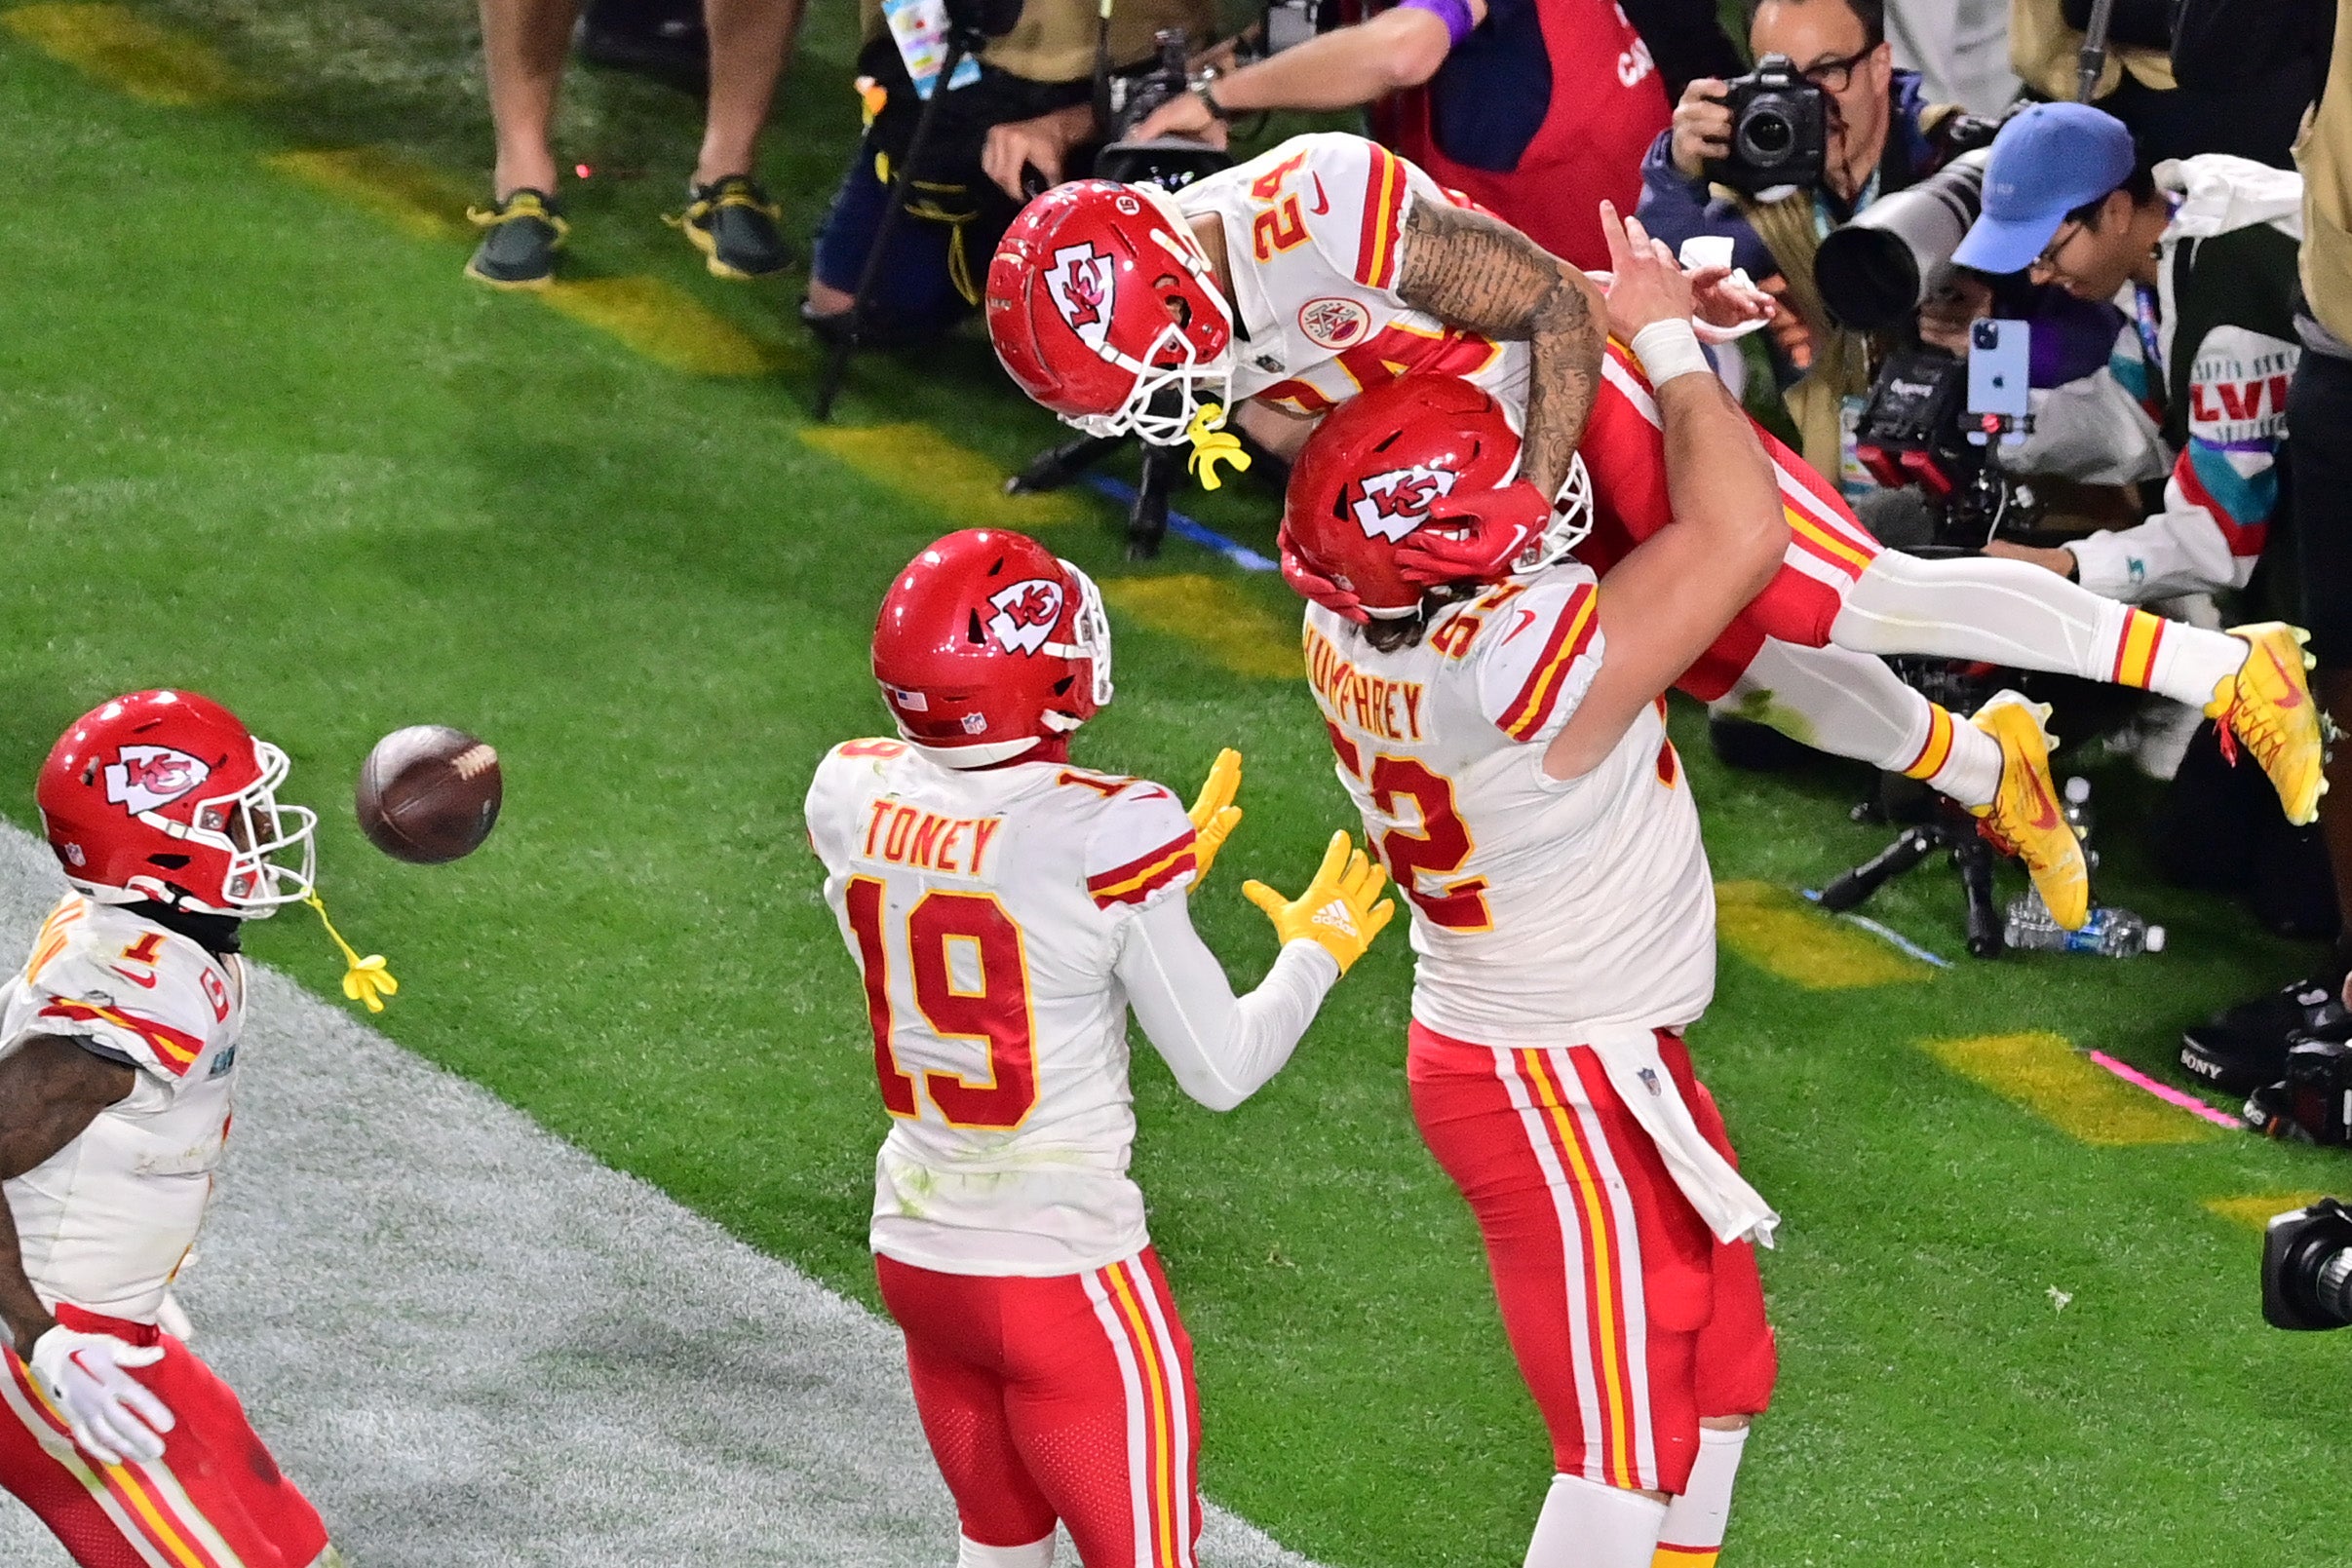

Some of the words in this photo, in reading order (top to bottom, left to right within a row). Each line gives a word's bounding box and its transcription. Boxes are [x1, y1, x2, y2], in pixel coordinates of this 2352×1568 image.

[1249, 148, 1312, 264] 24
[863, 798, 1003, 877] TONEY
[120, 932, 168, 967] 1
[1311, 914, 1358, 937] adidas
[844, 873, 1041, 1131] 19
[2179, 1048, 2224, 1080] SONY
